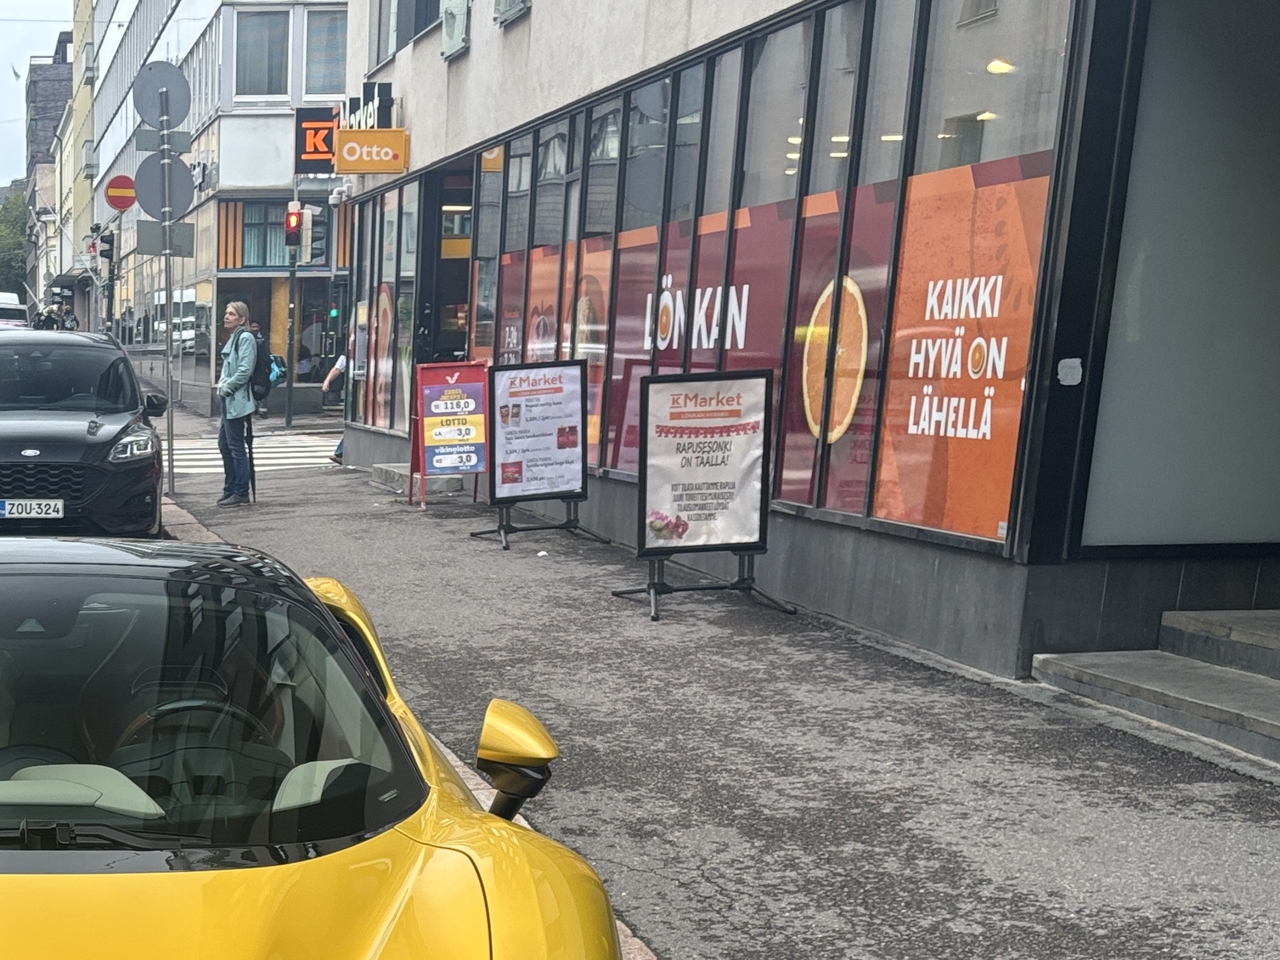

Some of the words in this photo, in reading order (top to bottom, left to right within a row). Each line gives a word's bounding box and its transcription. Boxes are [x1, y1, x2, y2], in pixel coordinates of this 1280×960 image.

[925, 275, 1004, 321] KAIKKI
[908, 326, 965, 378] HYVÄ
[967, 337, 1008, 379] ON
[683, 391, 743, 408] Market
[444, 401, 470, 411] 116,0
[907, 385, 995, 440] LÄHELLÄ
[441, 418, 467, 426] LOTTO
[457, 428, 471, 438] 3,0
[434, 445, 476, 454] vikinglotto
[676, 441, 732, 454] RAPUSESONKI
[458, 455, 472, 465] 3,0
[681, 456, 693, 468] ON
[8, 503, 60, 515] ZOU-324
